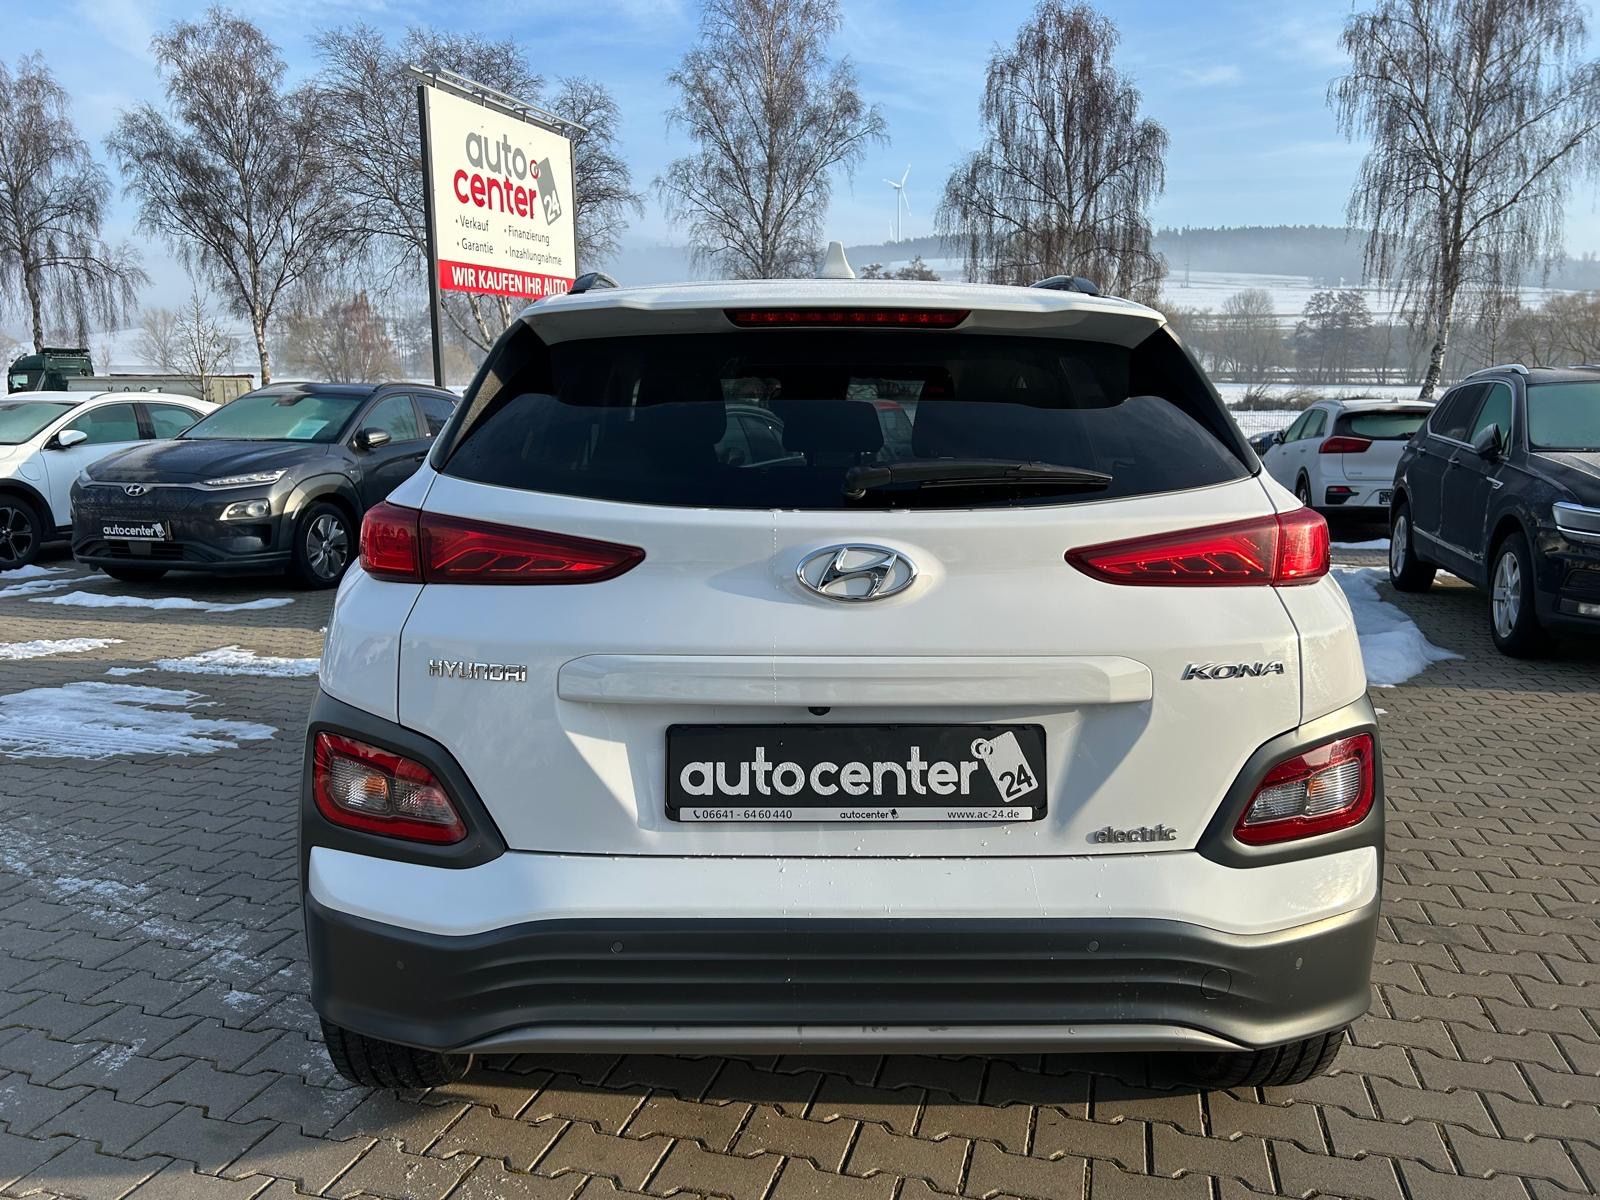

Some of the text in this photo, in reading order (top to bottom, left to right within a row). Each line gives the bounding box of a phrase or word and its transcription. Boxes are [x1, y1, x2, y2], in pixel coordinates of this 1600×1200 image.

[465, 131, 528, 181] auto
[453, 168, 537, 220] center
[543, 189, 561, 223] 24
[460, 215, 489, 232] Verkauf
[461, 237, 494, 254] Garantie
[508, 225, 550, 247] Finanzierung
[509, 246, 563, 266] Inzahlungnahme
[451, 265, 568, 296] WIR KAUFEN IHR AUTO
[102, 524, 155, 537] autocenter
[428, 659, 528, 683] HYUNDAI
[1180, 660, 1285, 681] KONA
[679, 745, 979, 797] autocenter
[998, 763, 1033, 799] 24
[702, 809, 735, 820] 06641
[839, 811, 890, 820] autocenter
[947, 808, 1020, 819] www.ac-24.de
[1094, 823, 1177, 843] electric
